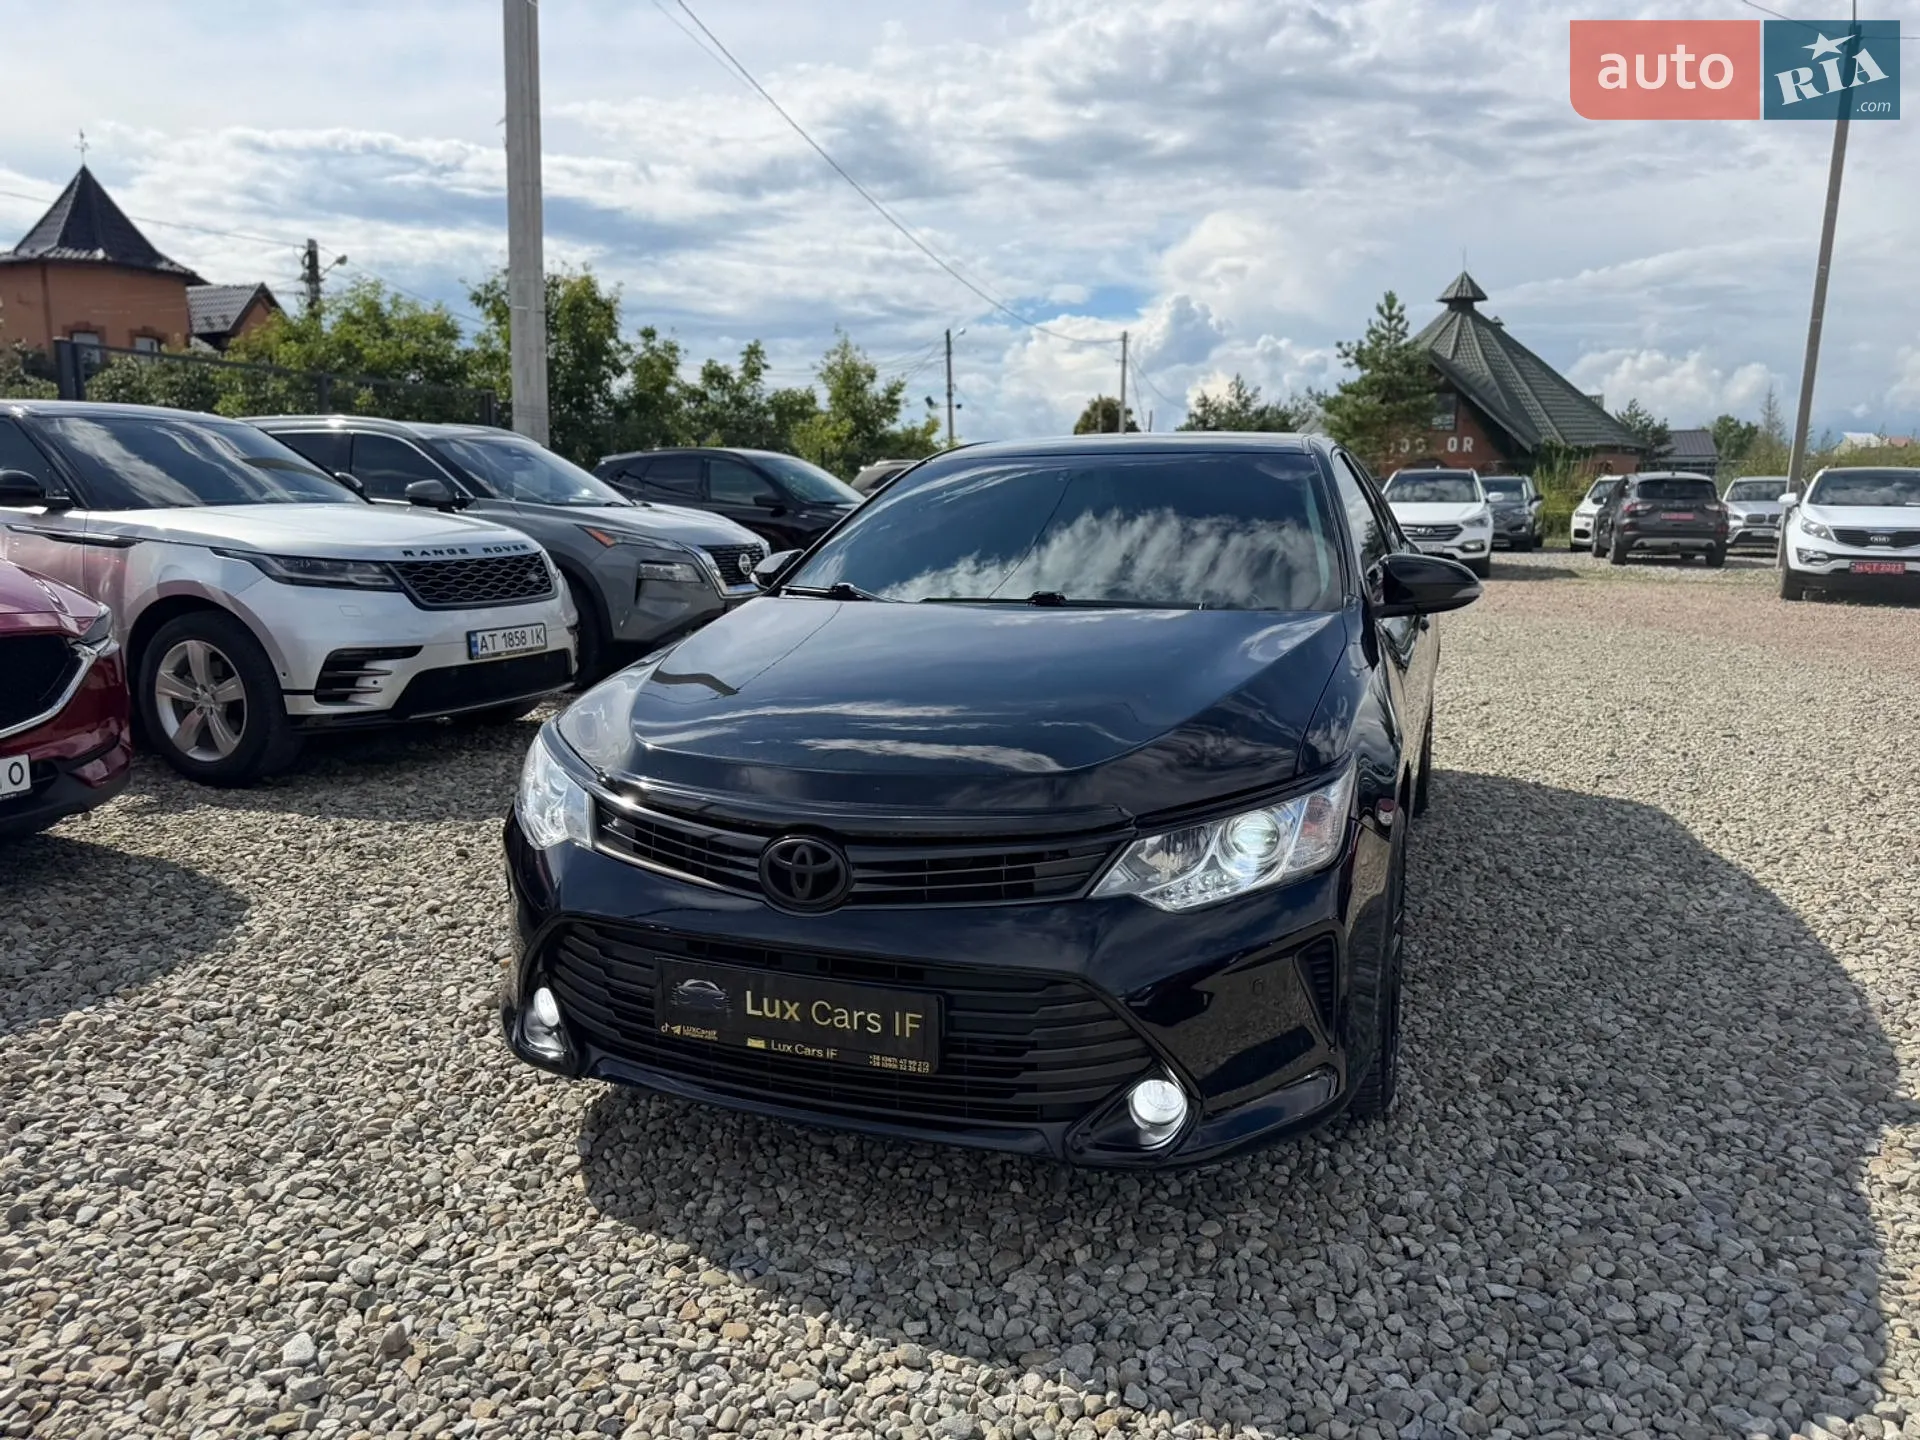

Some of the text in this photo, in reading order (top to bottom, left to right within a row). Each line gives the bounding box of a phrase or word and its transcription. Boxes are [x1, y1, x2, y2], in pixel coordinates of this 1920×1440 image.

[401, 544, 529, 557] RANGE ROVER
[480, 627, 544, 651] AT 1858 IK
[746, 990, 923, 1038] Lux Cars IF
[771, 1040, 838, 1059] Lux Cars IF
